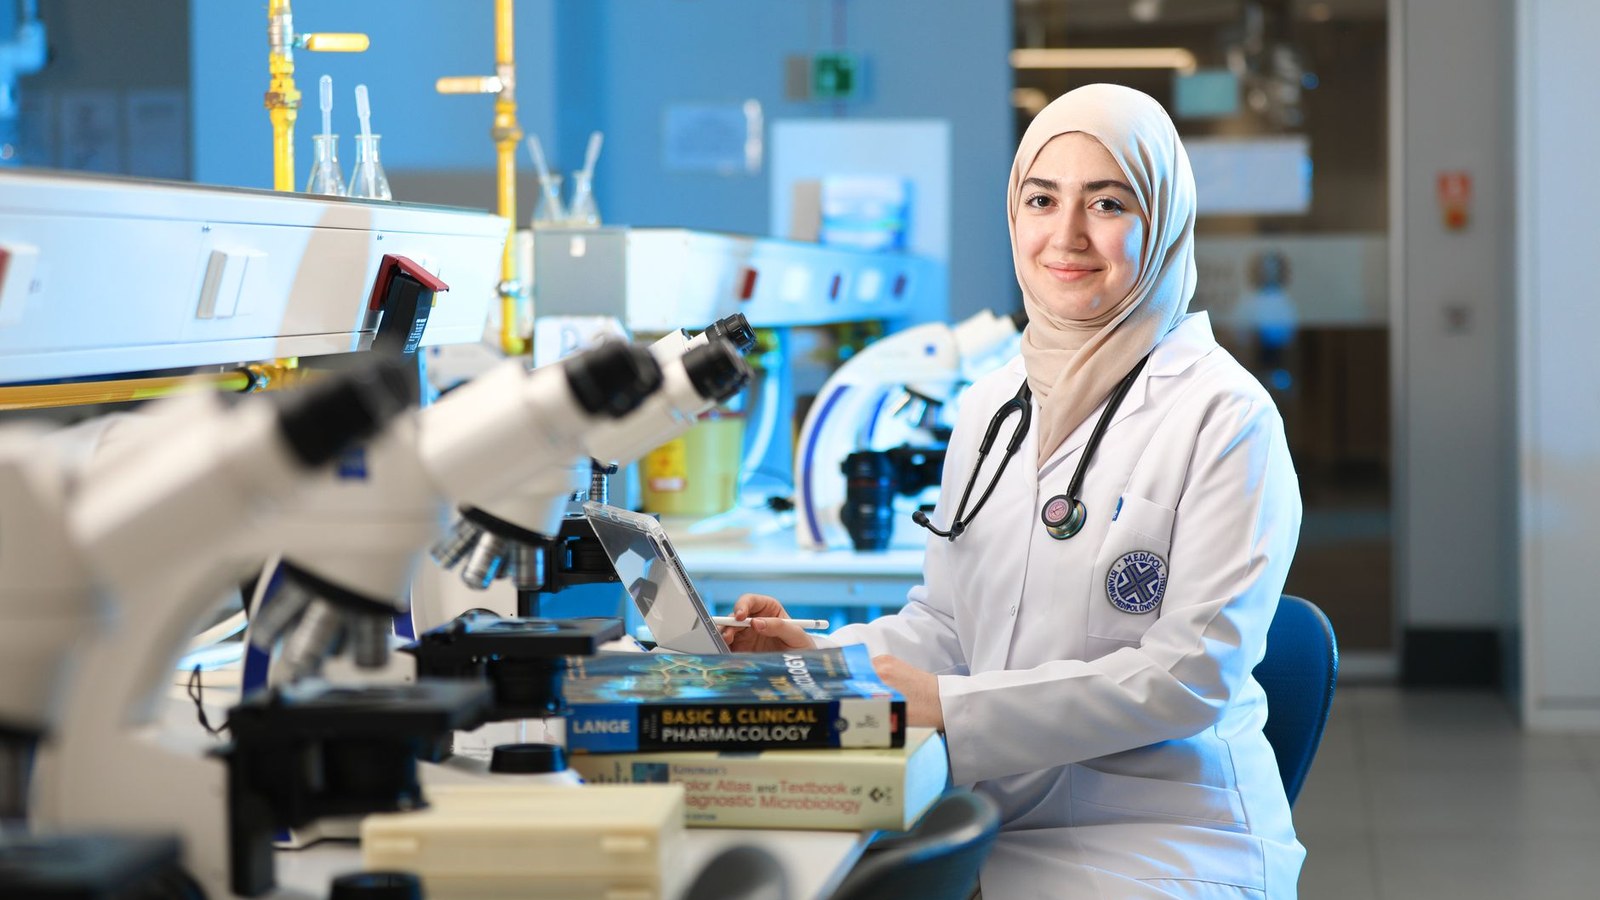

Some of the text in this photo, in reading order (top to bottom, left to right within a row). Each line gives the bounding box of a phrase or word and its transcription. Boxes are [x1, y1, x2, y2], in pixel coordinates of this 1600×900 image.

[661, 708, 818, 725] BASIC & CLINICAL
[572, 719, 631, 734] LANGE
[661, 726, 812, 742] PHARMACOLOGY
[780, 780, 848, 794] Textbook
[759, 796, 861, 815] Microbiology
